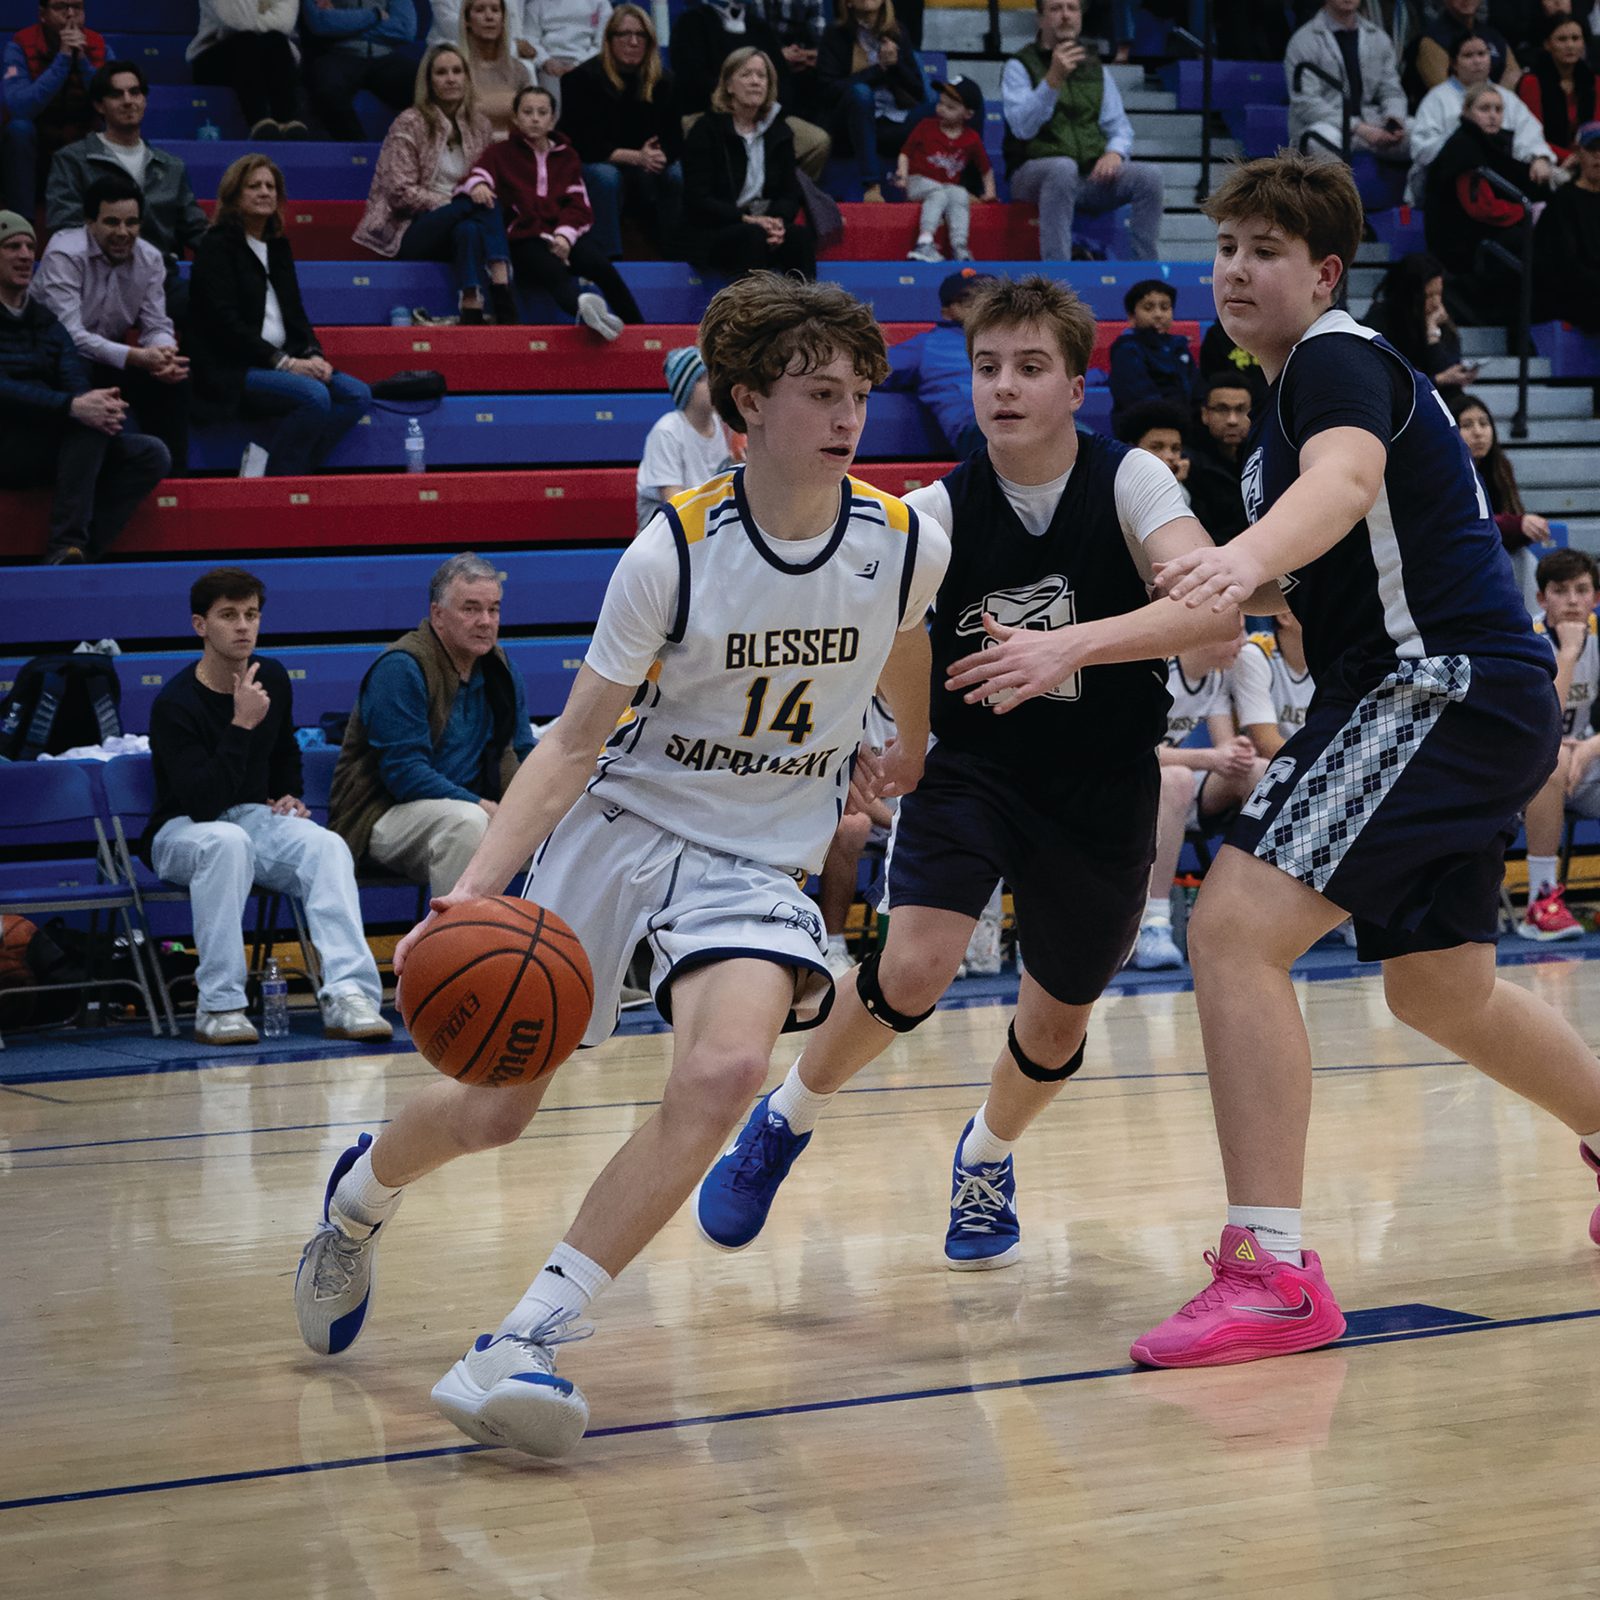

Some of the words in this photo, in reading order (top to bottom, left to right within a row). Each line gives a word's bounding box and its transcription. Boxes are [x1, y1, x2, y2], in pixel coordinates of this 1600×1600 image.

[725, 626, 859, 670] BLESSED
[738, 676, 815, 746] 14
[424, 990, 481, 1062] EVOLU
